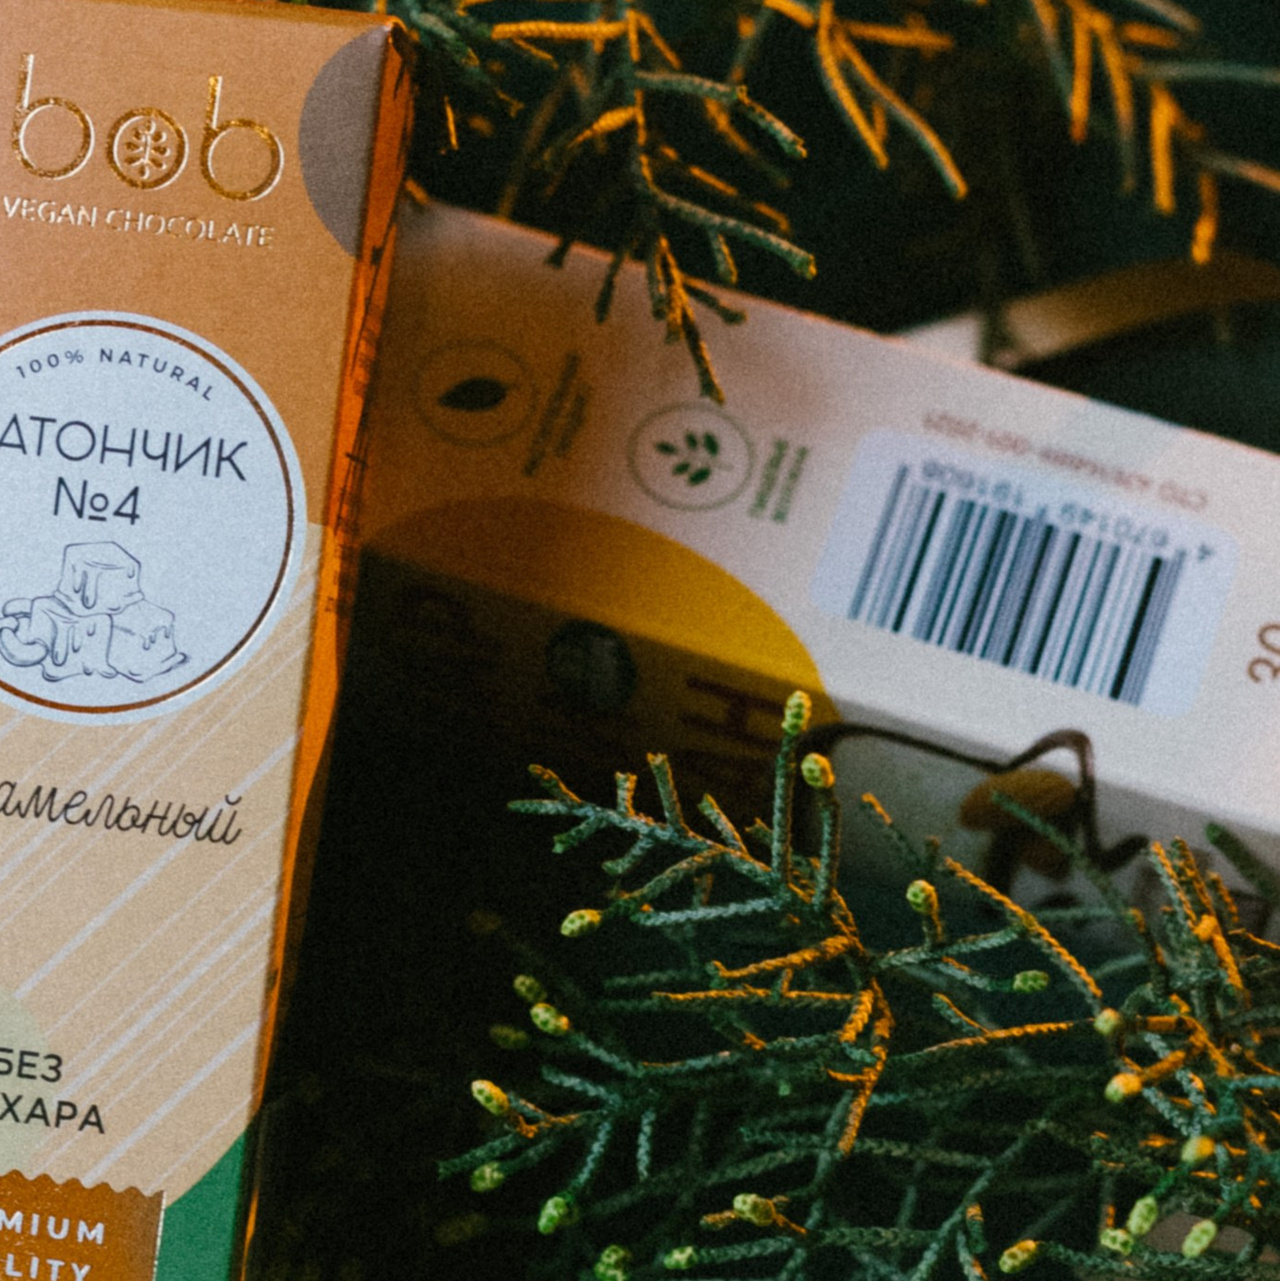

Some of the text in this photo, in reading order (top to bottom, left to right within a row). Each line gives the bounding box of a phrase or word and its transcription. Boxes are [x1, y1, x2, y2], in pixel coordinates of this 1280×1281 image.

[10, 53, 286, 202] bob
[3, 195, 276, 249] VEGAN CHOCOLATE
[16, 348, 214, 402] 100% NATURAL
[52, 477, 143, 526] №4
